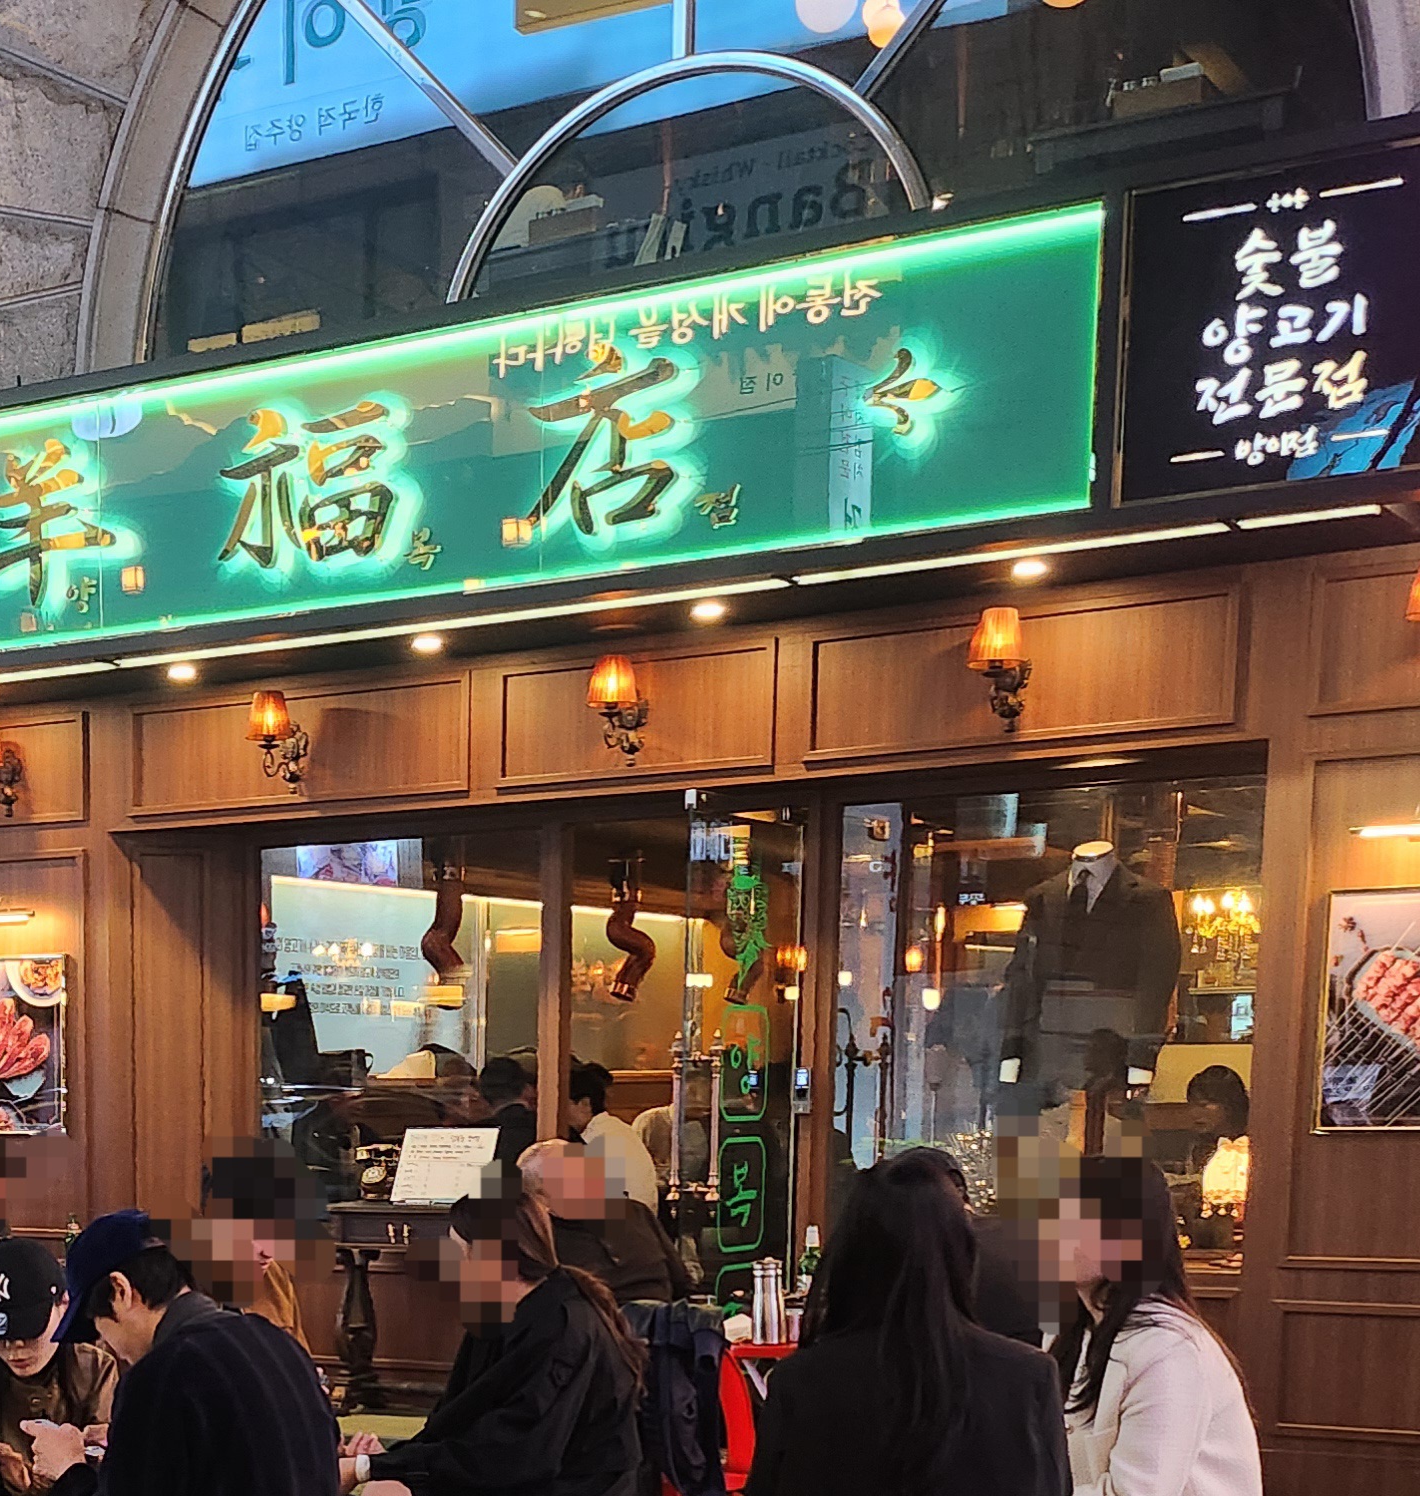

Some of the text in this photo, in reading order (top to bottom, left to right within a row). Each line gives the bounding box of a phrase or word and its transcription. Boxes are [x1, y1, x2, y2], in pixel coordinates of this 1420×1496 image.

[1235, 218, 1344, 301] 숯불
[1201, 292, 1368, 366] 양고기
[1195, 349, 1368, 426] 전문점
[1234, 424, 1319, 466] 방이점
